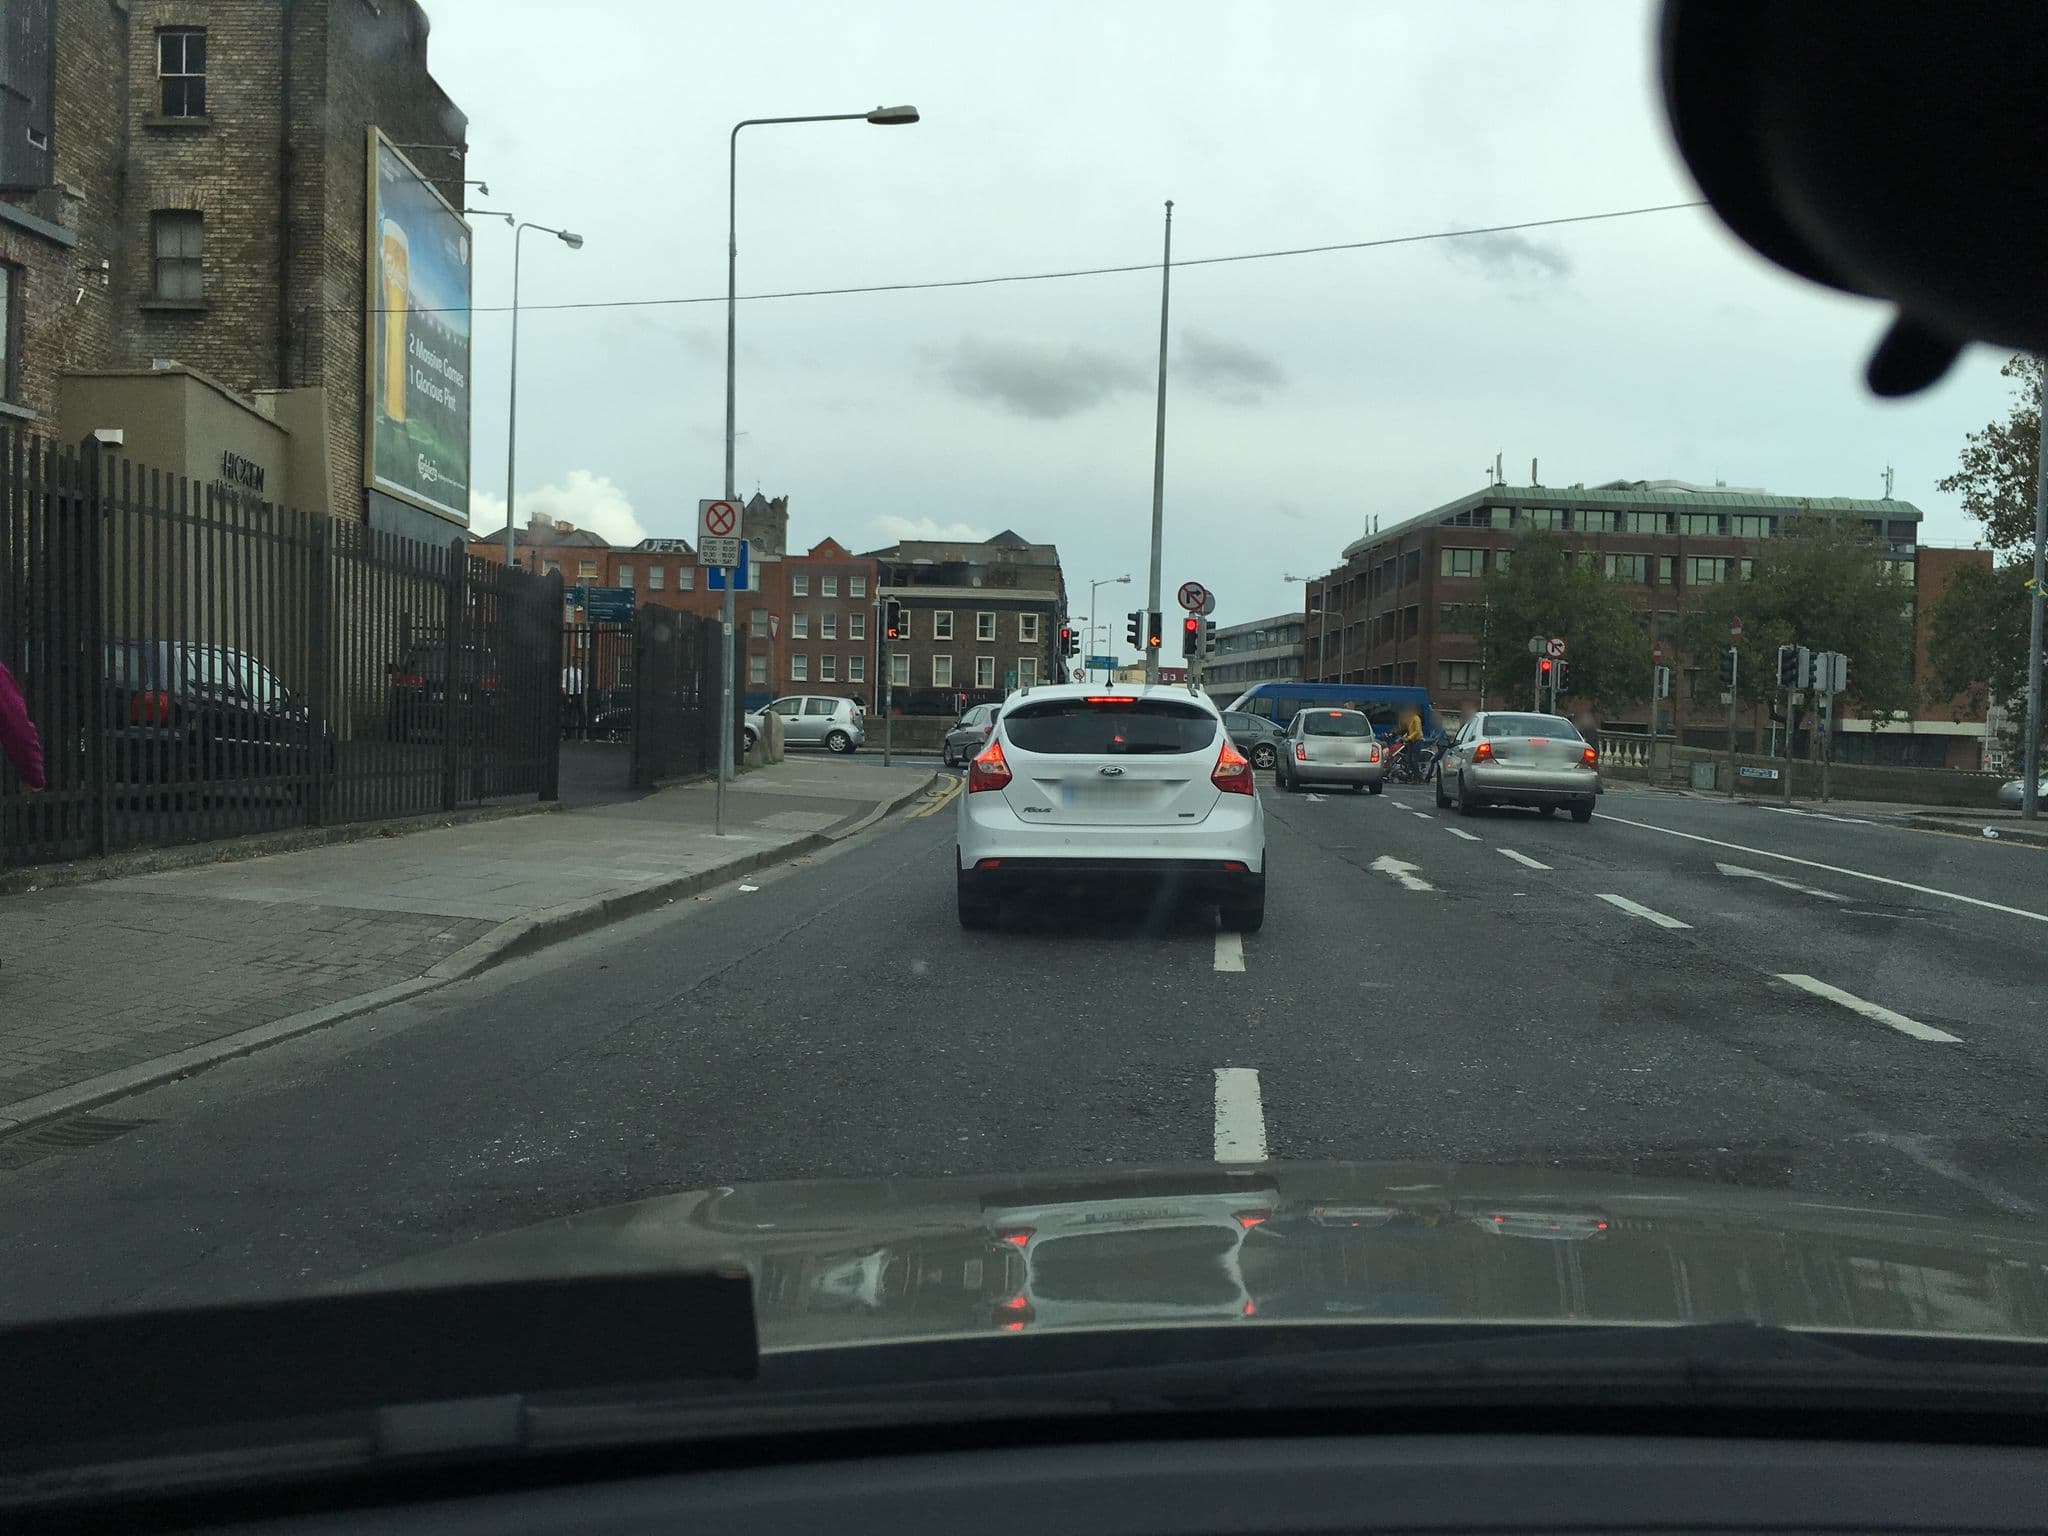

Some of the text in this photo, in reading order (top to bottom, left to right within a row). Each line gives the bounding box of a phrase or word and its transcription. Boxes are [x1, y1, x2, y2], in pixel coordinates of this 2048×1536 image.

[409, 332, 465, 389] 2 Massive Games
[415, 369, 443, 404] Glorious
